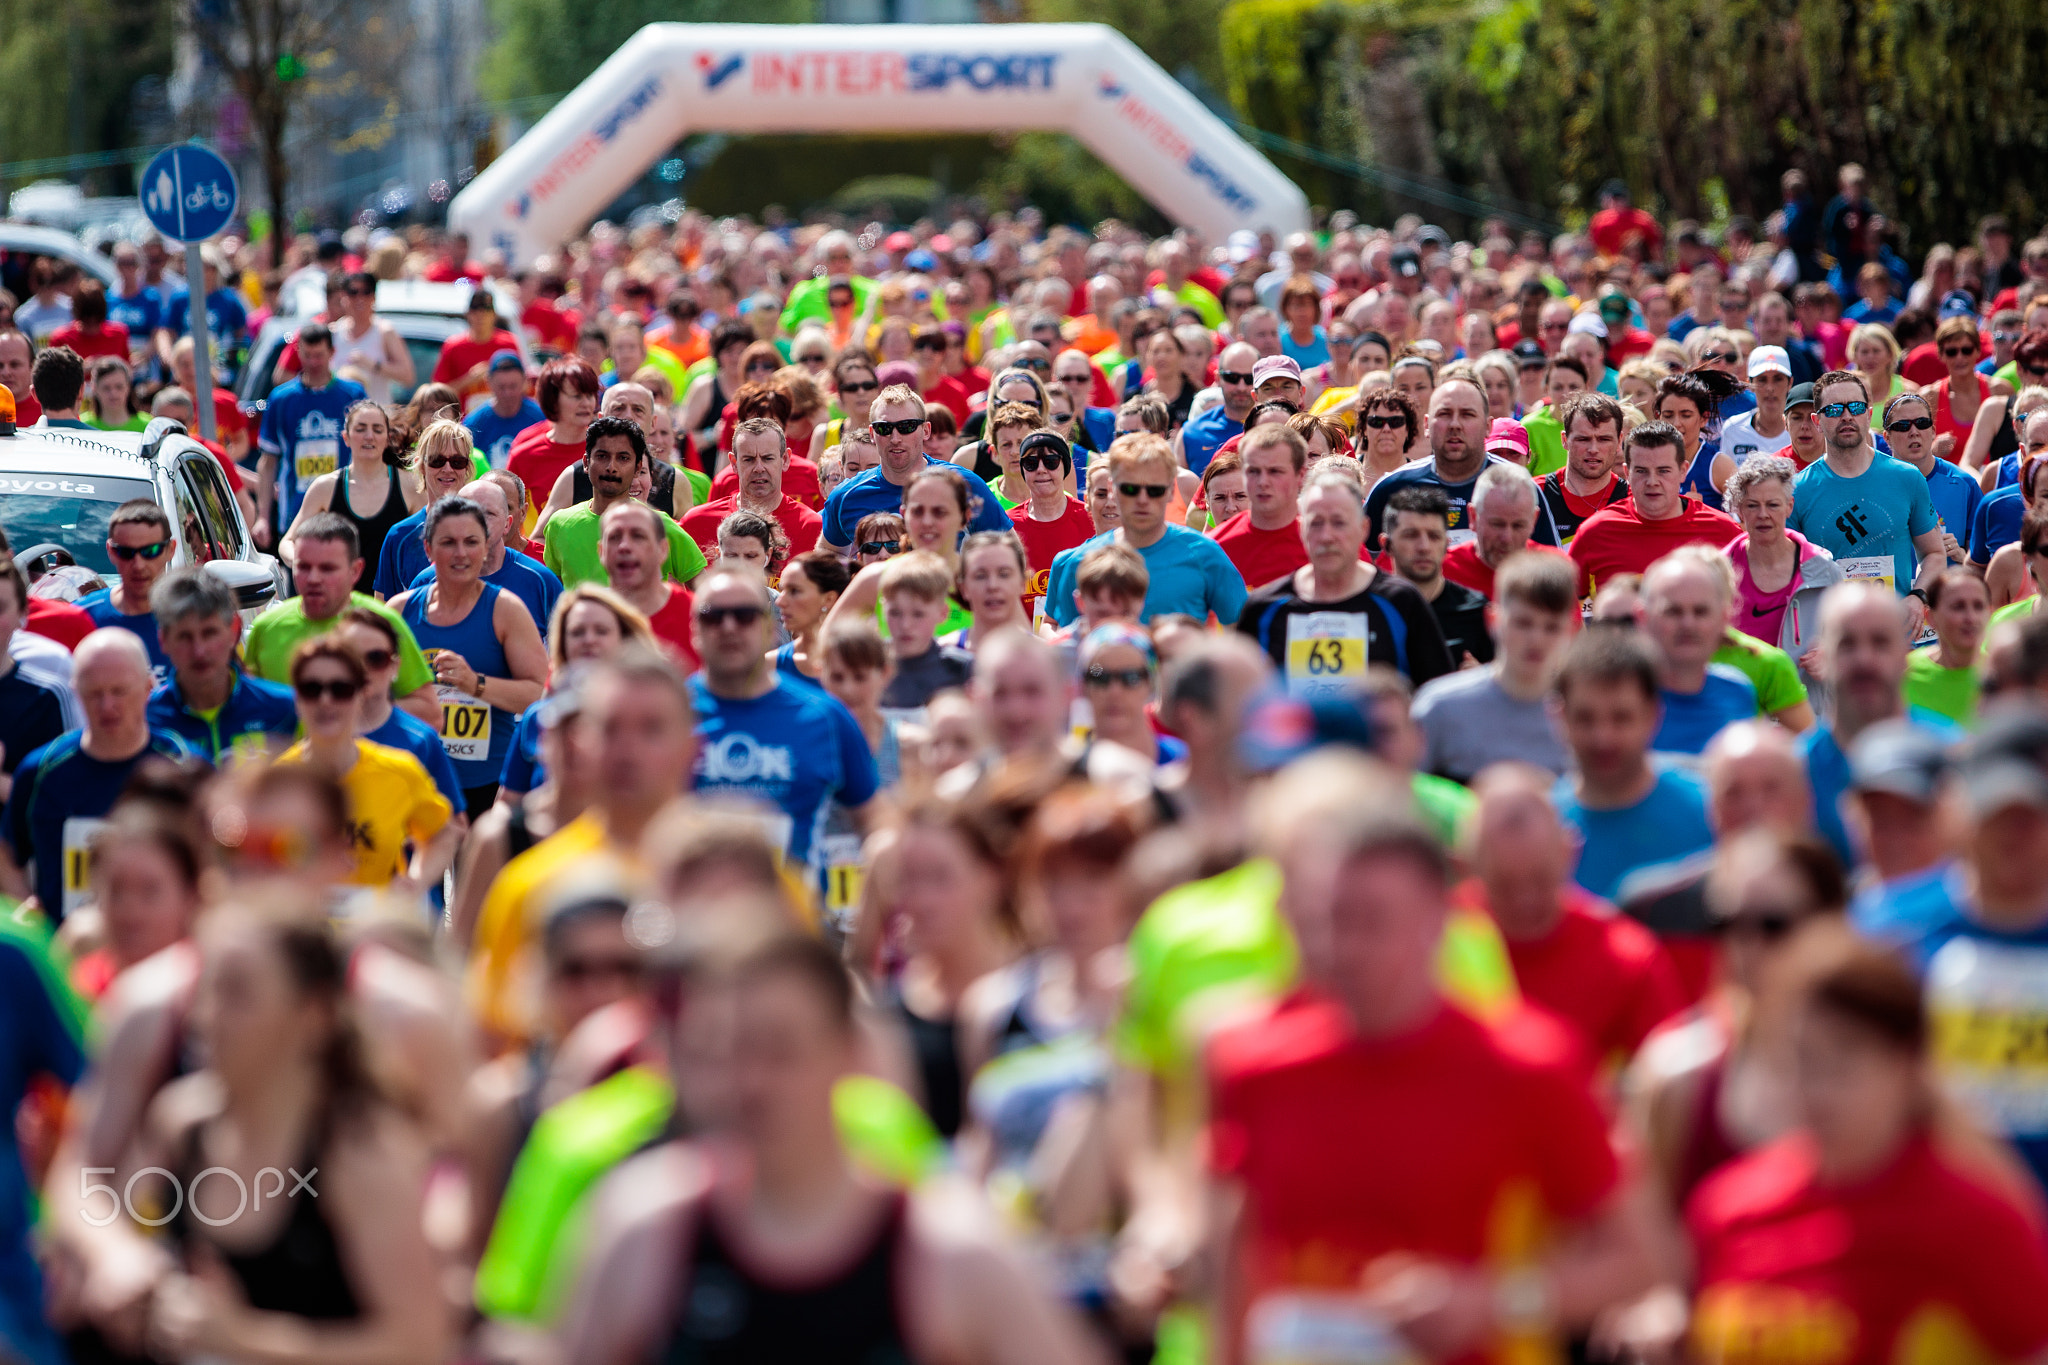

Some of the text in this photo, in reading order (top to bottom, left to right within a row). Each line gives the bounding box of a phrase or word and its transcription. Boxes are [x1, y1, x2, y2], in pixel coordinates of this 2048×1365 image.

[751, 50, 1060, 93] INTERSPORT
[528, 75, 664, 203] INTERSPORT
[1115, 92, 1258, 215] INTERSPORT
[1308, 640, 1343, 676] 63
[442, 705, 488, 738] 107
